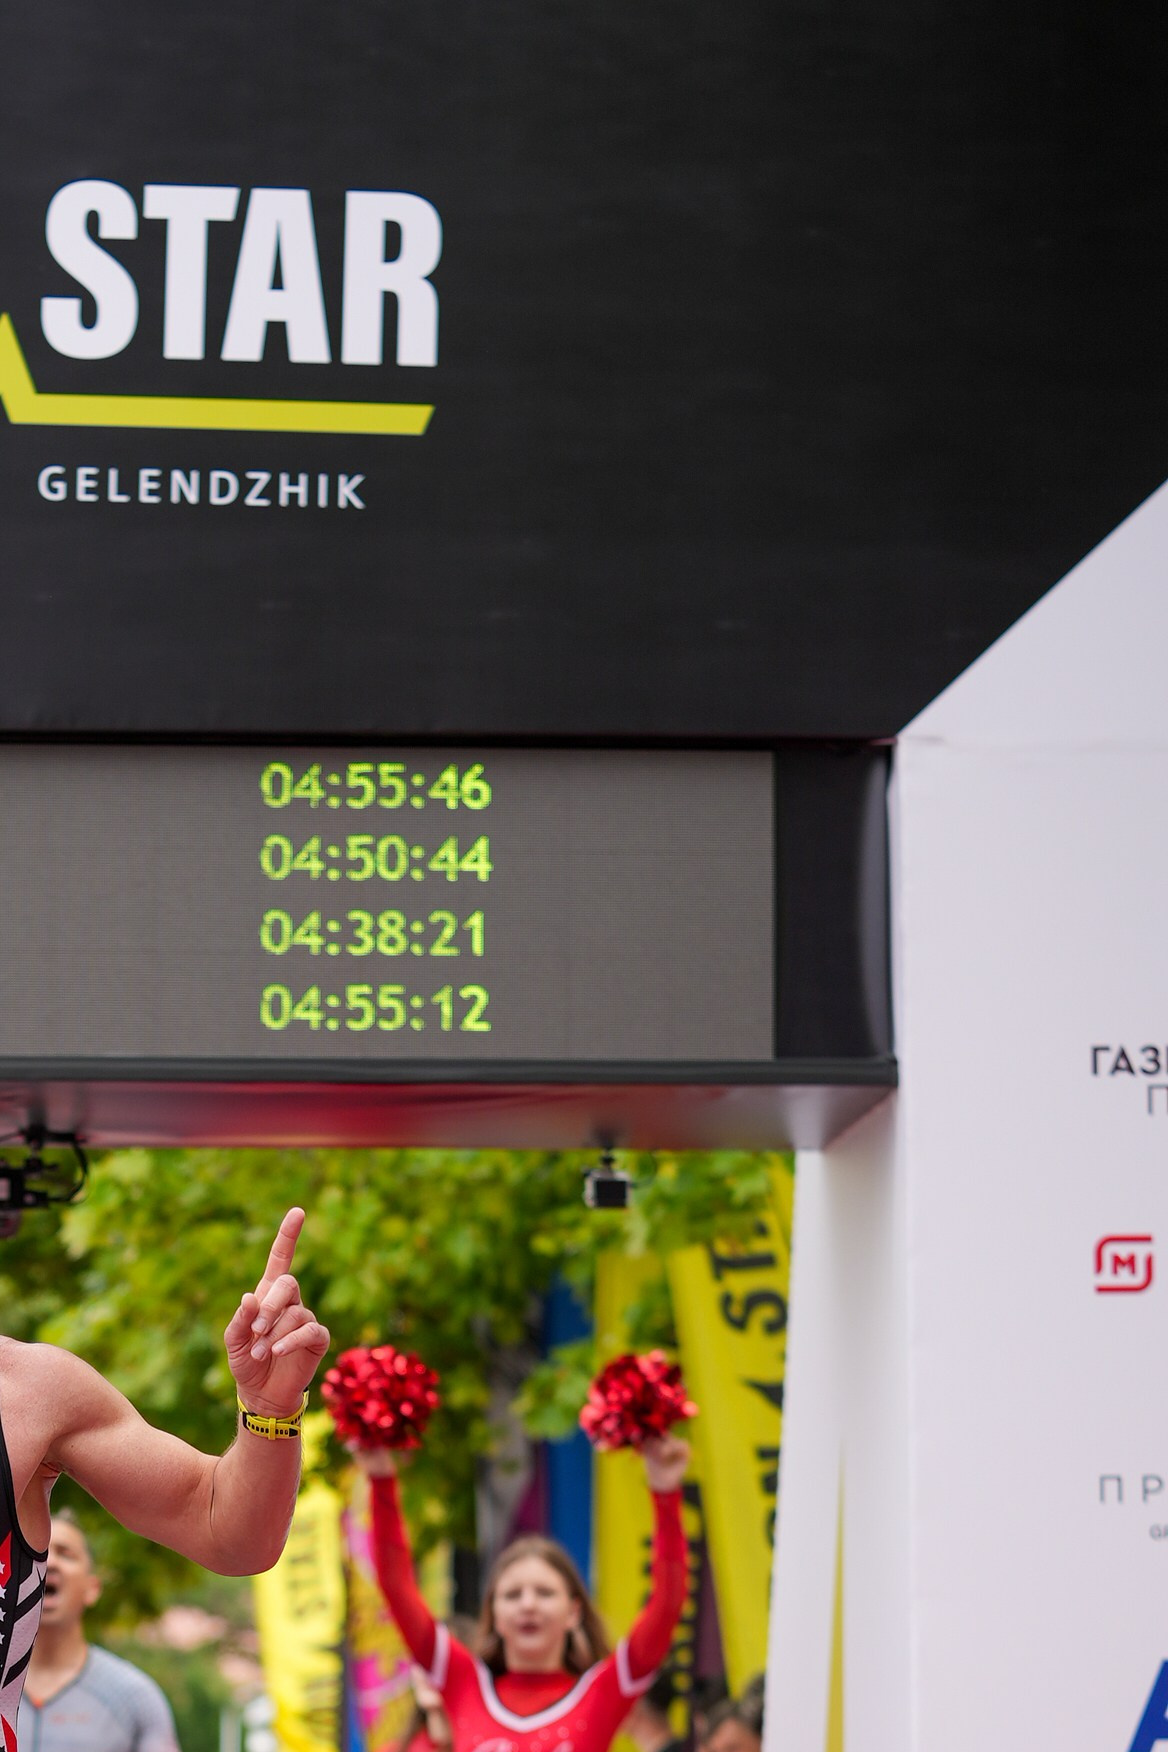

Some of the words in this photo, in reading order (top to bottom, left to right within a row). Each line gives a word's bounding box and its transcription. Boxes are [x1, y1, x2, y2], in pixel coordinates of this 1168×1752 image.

[41, 180, 443, 367] STAR
[38, 465, 365, 509] GELENDZHIK
[259, 761, 492, 810] 04:55:46
[259, 833, 494, 881] 04:50:44
[259, 908, 485, 956] 04:38:21
[259, 983, 492, 1032] 04:55:12
[1091, 1045, 1168, 1077] ГАЗ
